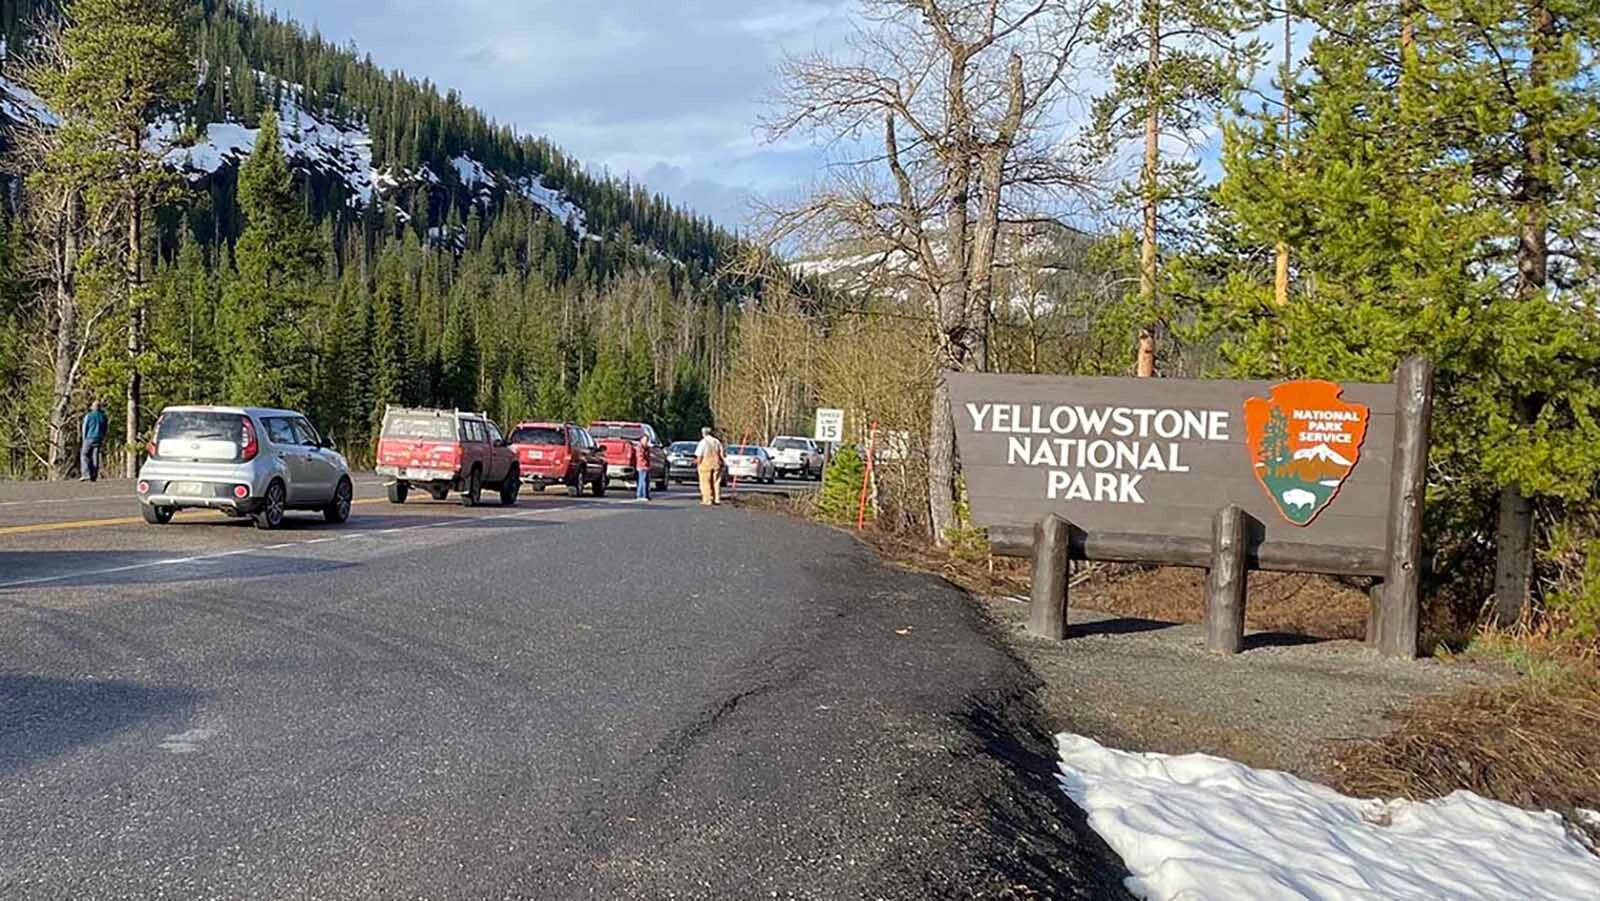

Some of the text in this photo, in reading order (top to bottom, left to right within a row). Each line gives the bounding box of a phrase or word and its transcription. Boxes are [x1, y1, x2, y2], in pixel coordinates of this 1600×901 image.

[966, 403, 1229, 440] YELLOWSTONE
[1293, 410, 1360, 421] NATIONAL
[821, 425, 837, 438] 15
[1308, 422, 1343, 431] PARK
[1299, 432, 1352, 443] SERVICE
[1008, 437, 1189, 472] NATIONAL
[1047, 471, 1145, 503] PARK
